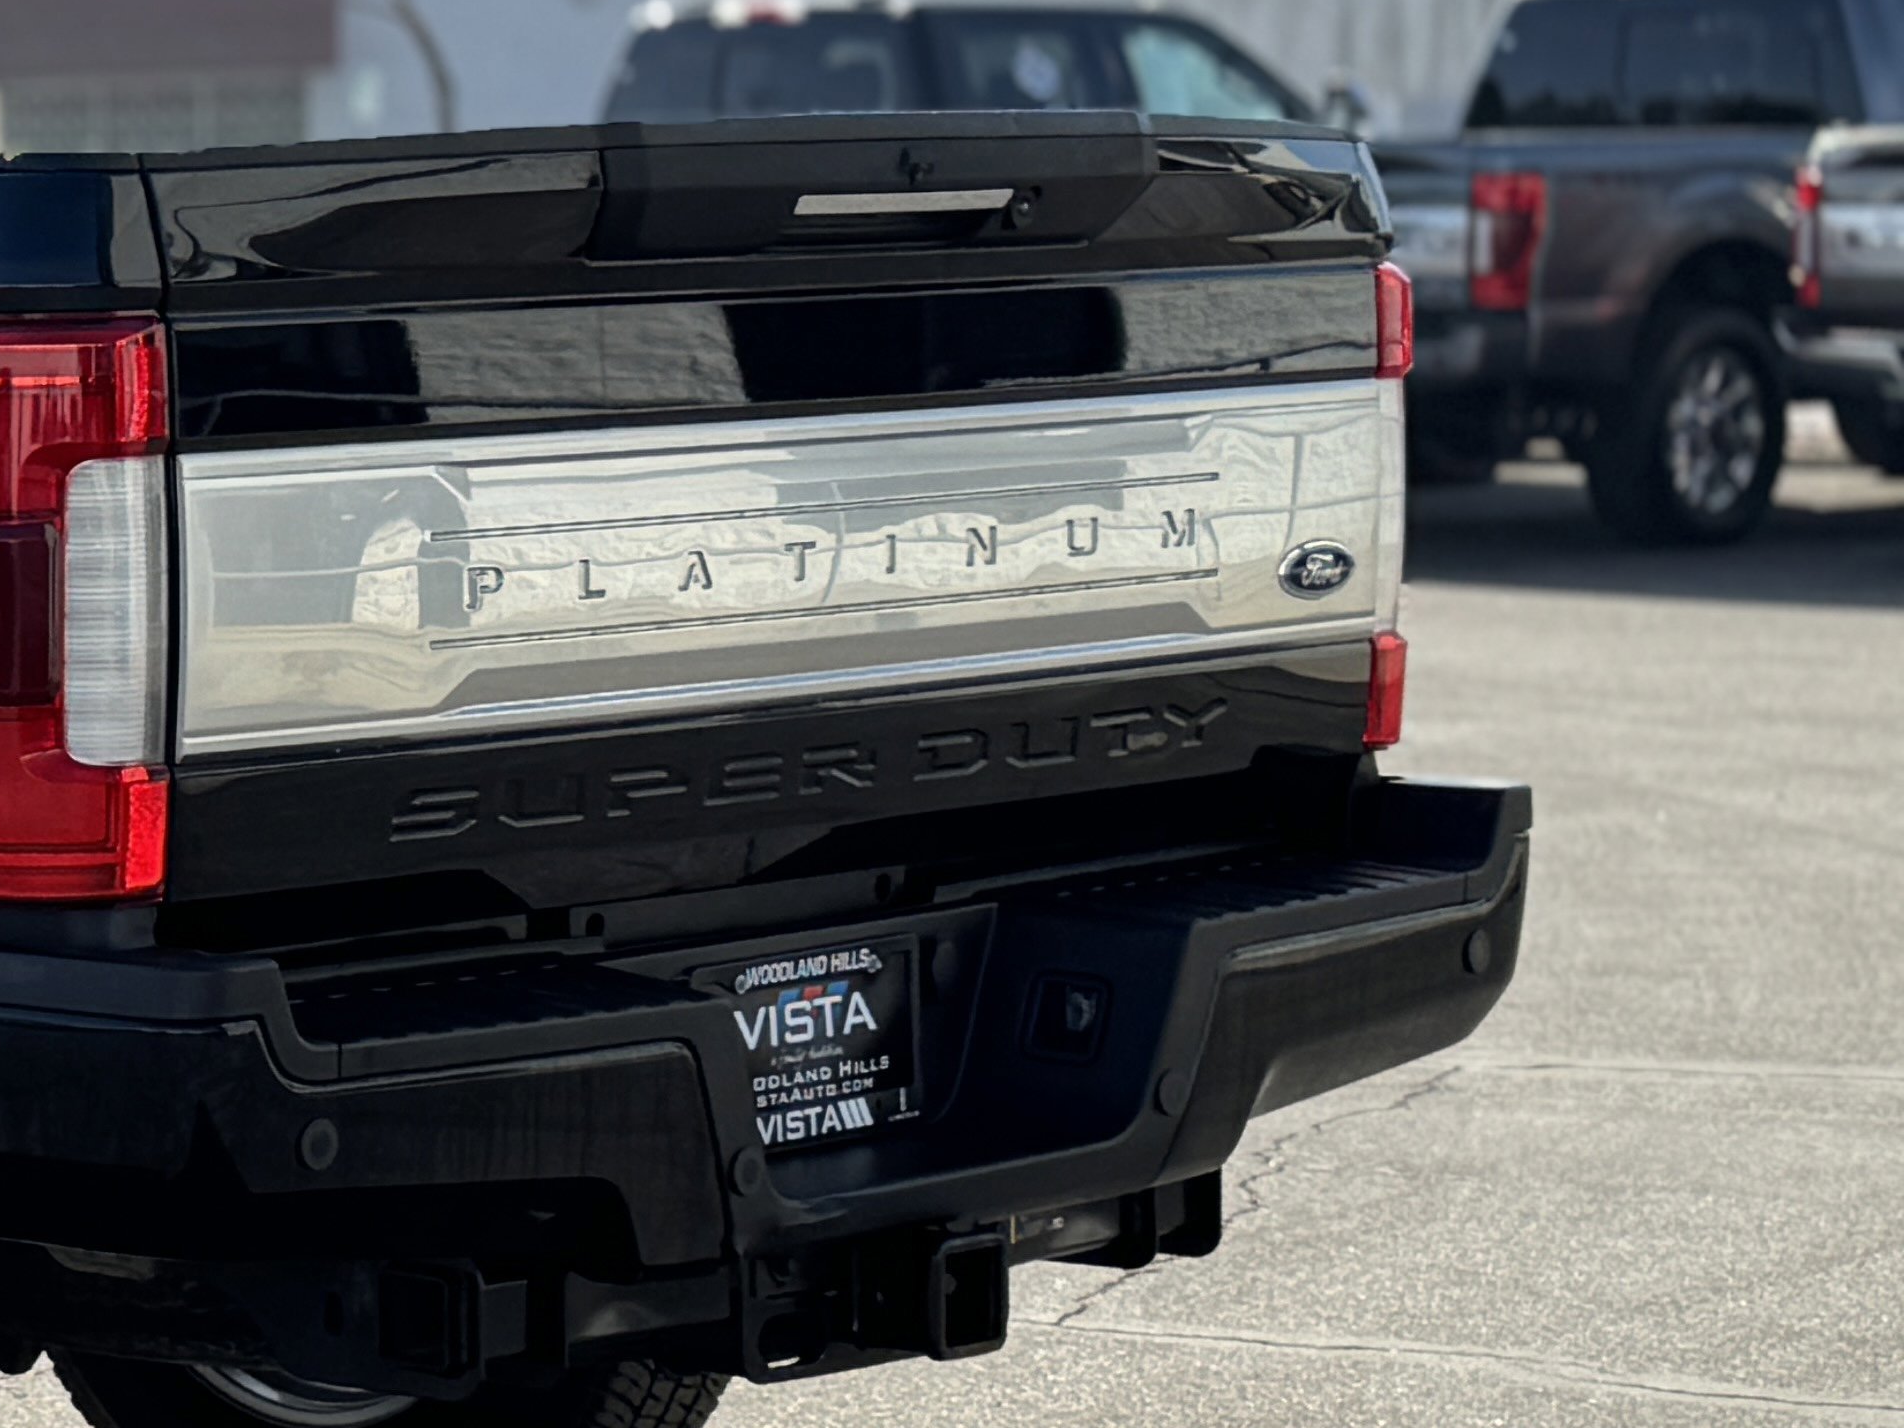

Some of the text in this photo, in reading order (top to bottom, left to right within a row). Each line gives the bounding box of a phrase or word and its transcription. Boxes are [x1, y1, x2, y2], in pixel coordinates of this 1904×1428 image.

[464, 508, 1196, 611] PLATINUM
[390, 697, 1230, 842] SUPER DUTY
[744, 947, 871, 986] WOODLAND HILLS
[733, 991, 878, 1051] VISTA
[753, 1065, 832, 1092] ODLAND
[838, 1055, 890, 1078] HILLS
[755, 1077, 875, 1109] STAAUTO.COM
[756, 1104, 842, 1145] VISTA
